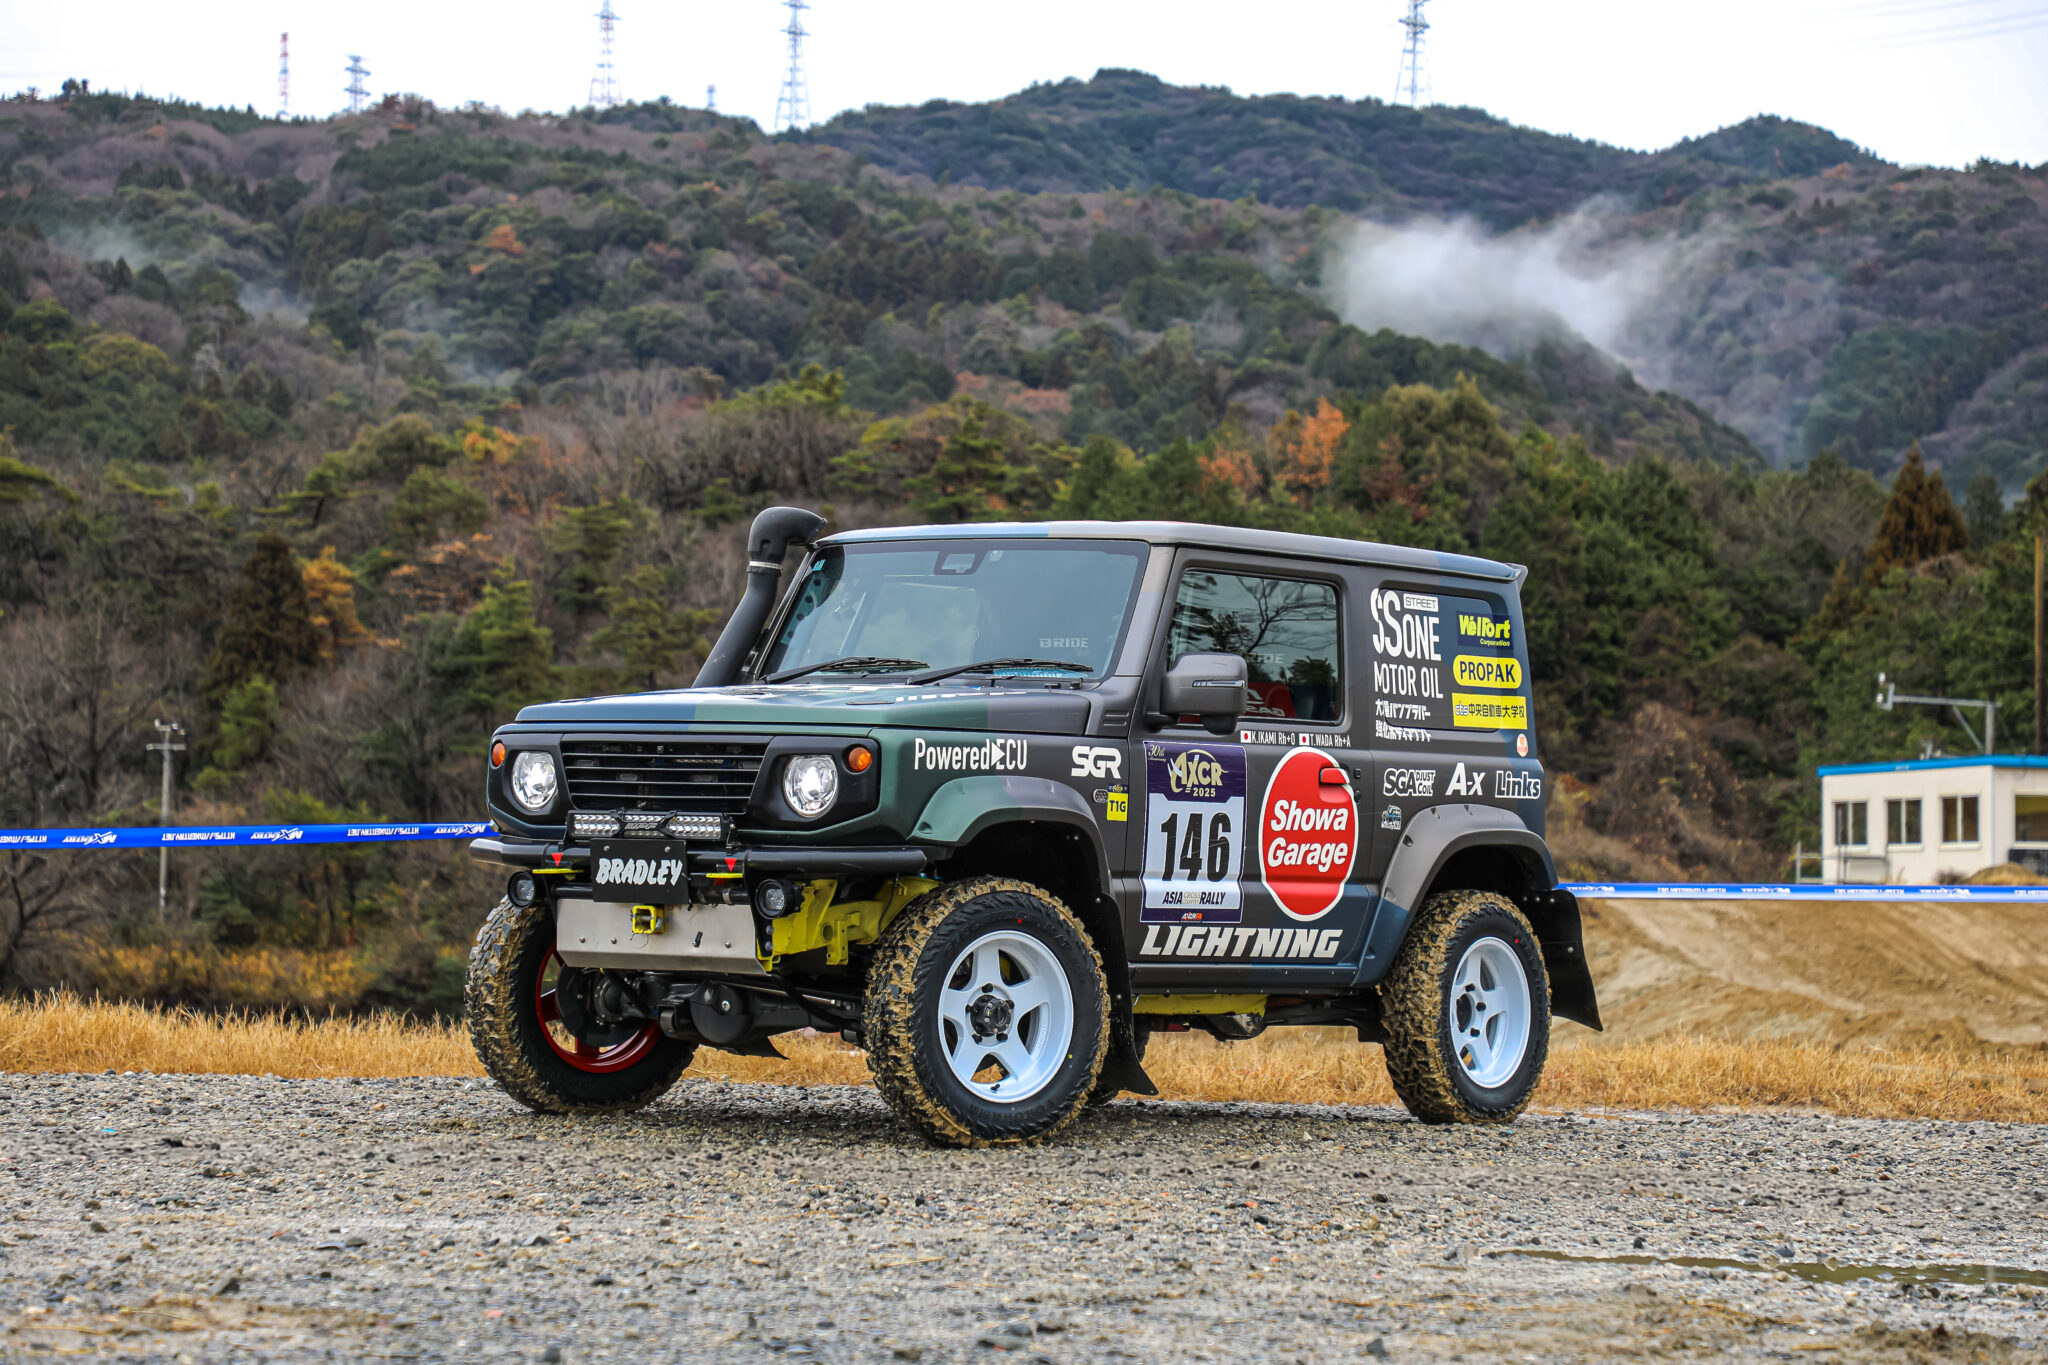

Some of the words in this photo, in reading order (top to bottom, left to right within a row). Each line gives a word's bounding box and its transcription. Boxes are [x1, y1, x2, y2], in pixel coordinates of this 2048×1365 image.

[1405, 596, 1437, 609] STREET
[1039, 638, 1088, 648] BRIDE
[1479, 638, 1511, 647] Corporation
[1373, 661, 1417, 697] MOTOR
[1420, 666, 1443, 699] OIL
[1459, 660, 1516, 683] PROPAK
[1251, 730, 1277, 744] K.IKAMI
[1310, 733, 1334, 747] T.WADA
[1334, 735, 1351, 747] Rh+A
[914, 738, 990, 770] Powered
[1071, 746, 1122, 779] SGR
[1192, 787, 1216, 797] 2025
[1495, 771, 1541, 799] Links
[1109, 799, 1127, 813] T1G
[1270, 799, 1349, 832] Showa
[1160, 812, 1232, 883] 146
[1267, 836, 1348, 873] Garage
[595, 857, 683, 886] BRADLEY
[1162, 891, 1183, 905] ASIA
[1199, 891, 1226, 905] RALLY
[1139, 925, 1344, 959] LIGHTNING
